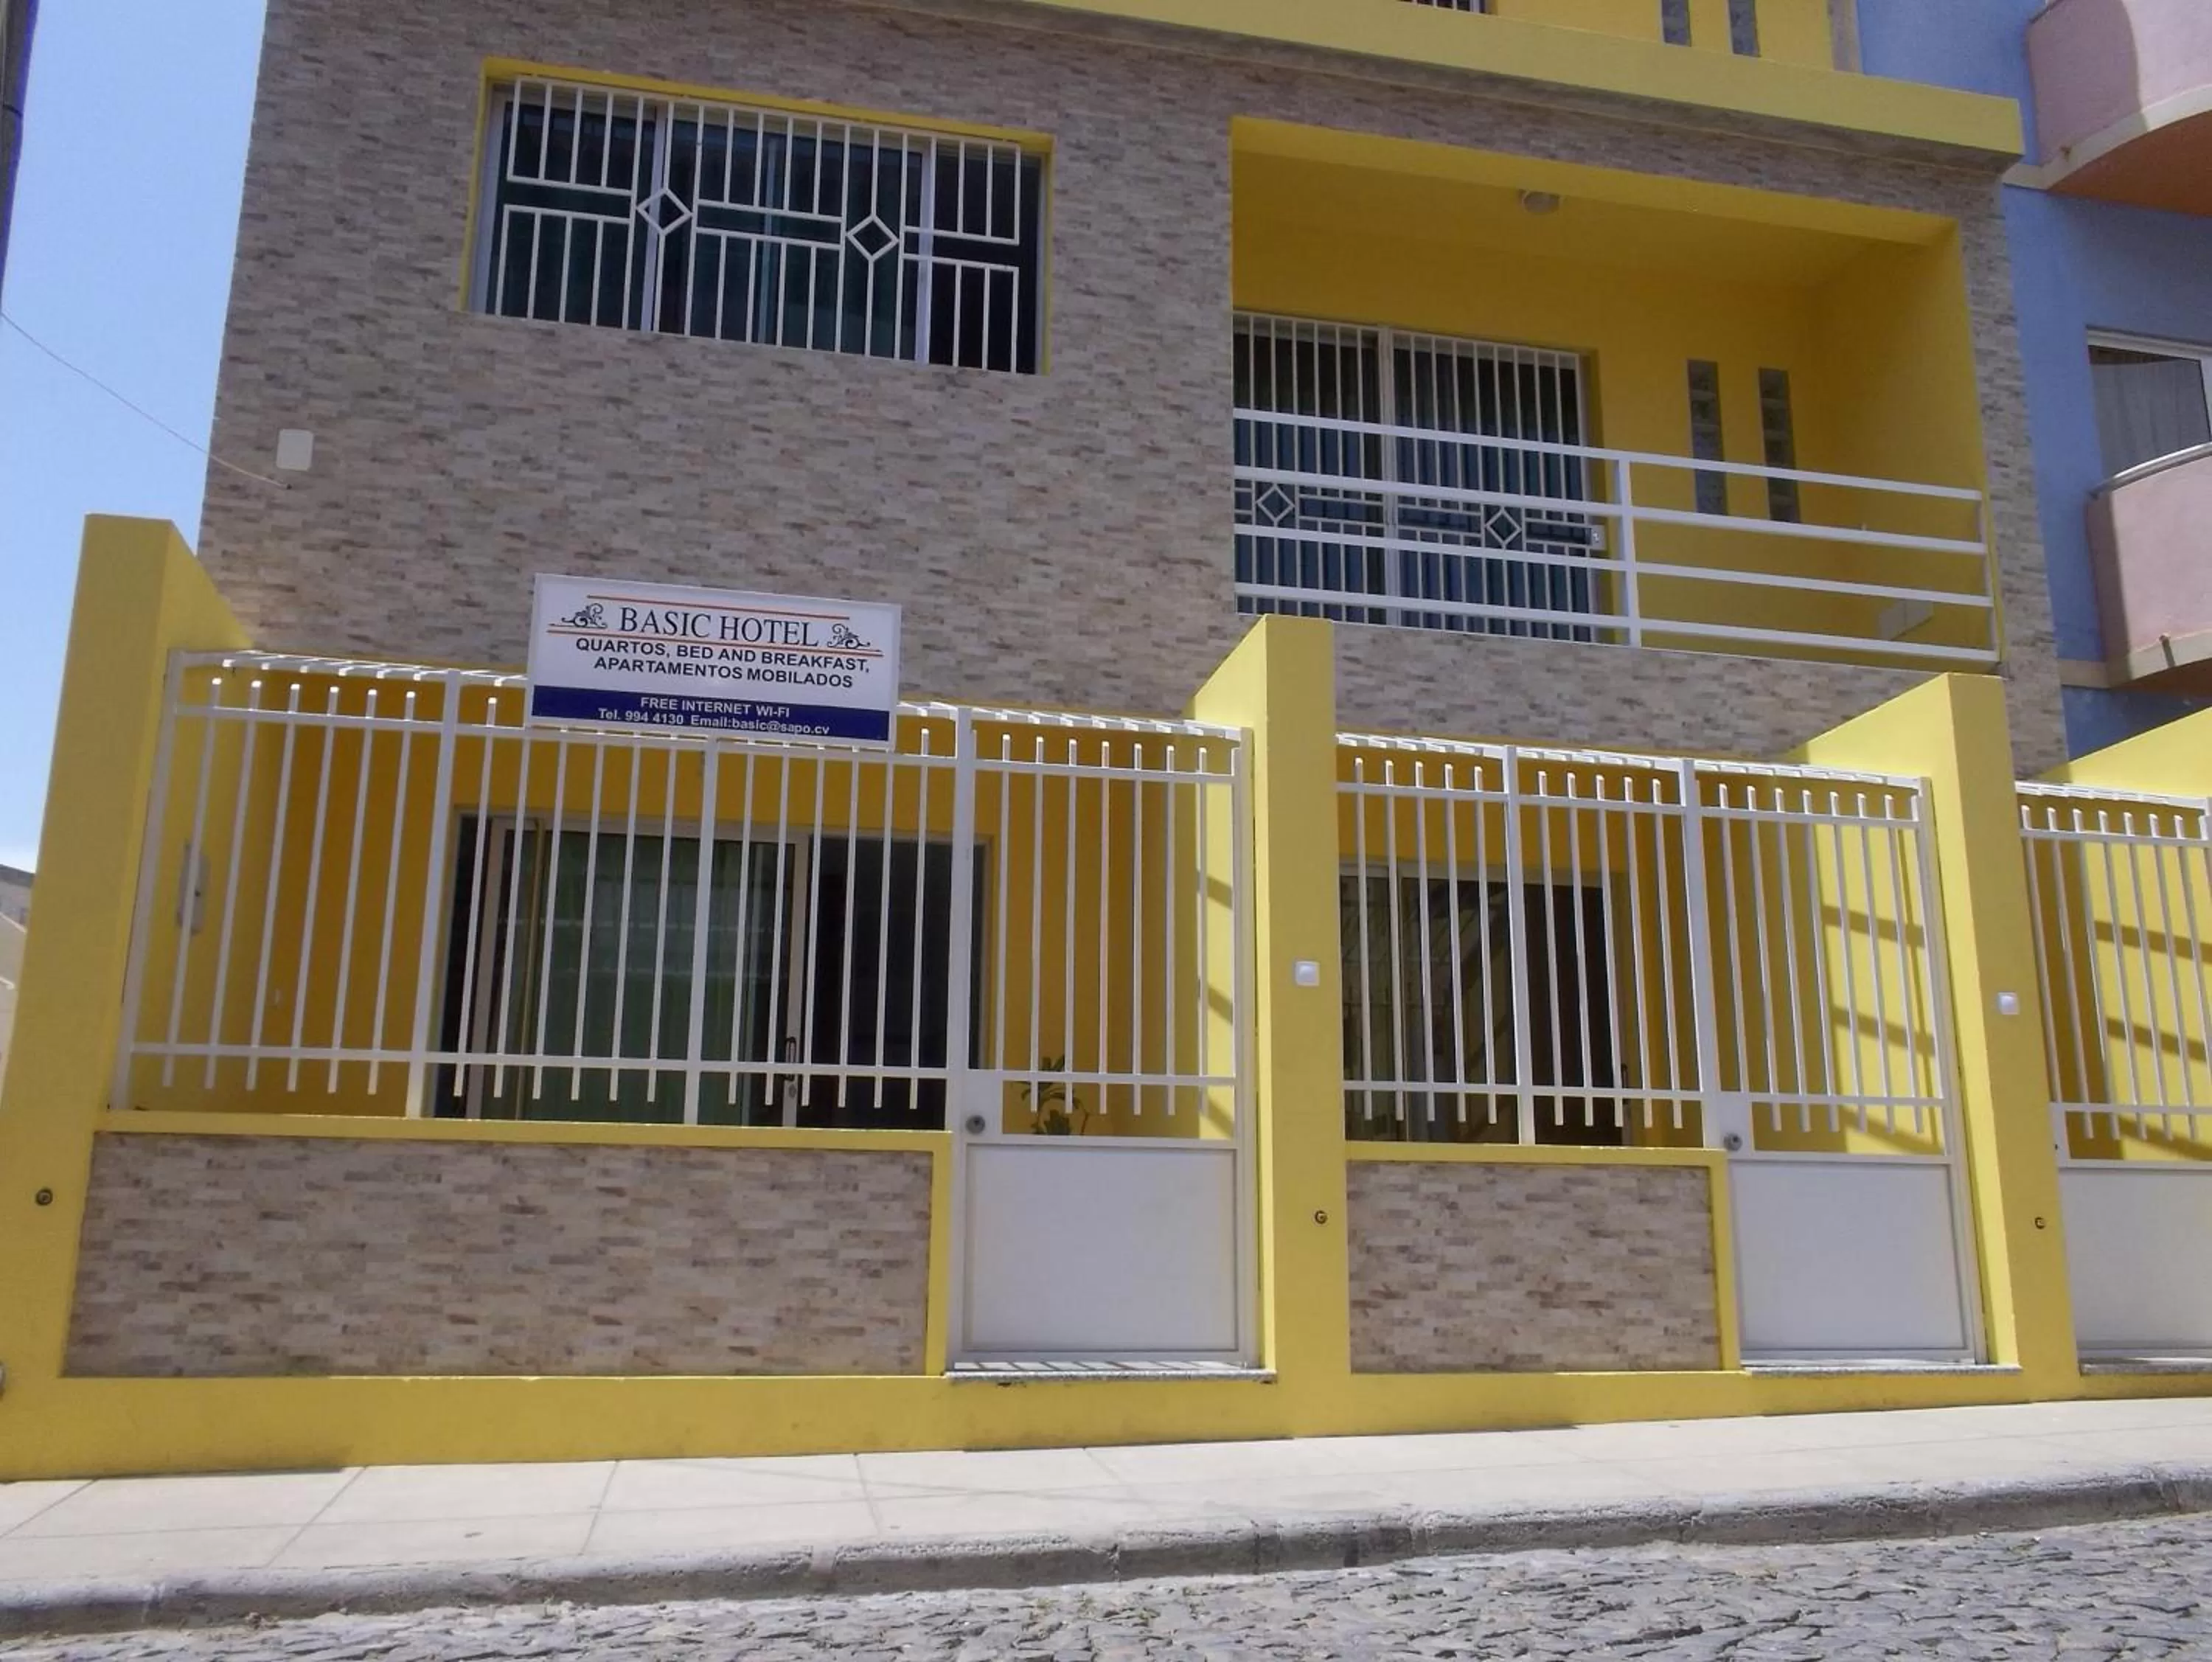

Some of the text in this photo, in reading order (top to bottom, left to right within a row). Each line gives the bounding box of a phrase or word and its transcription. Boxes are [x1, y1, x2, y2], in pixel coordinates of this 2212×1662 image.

[619, 606, 819, 647] BASIC HOTEL
[576, 638, 870, 673] QUARTOS, BED AND BREAKFAST,
[594, 656, 853, 688] APARTAMENTOS MOBILADOS
[598, 708, 621, 721] Tel.
[625, 710, 649, 723] 994
[652, 712, 684, 726] 4130
[641, 697, 790, 717] FREE INTERNET WI-FI
